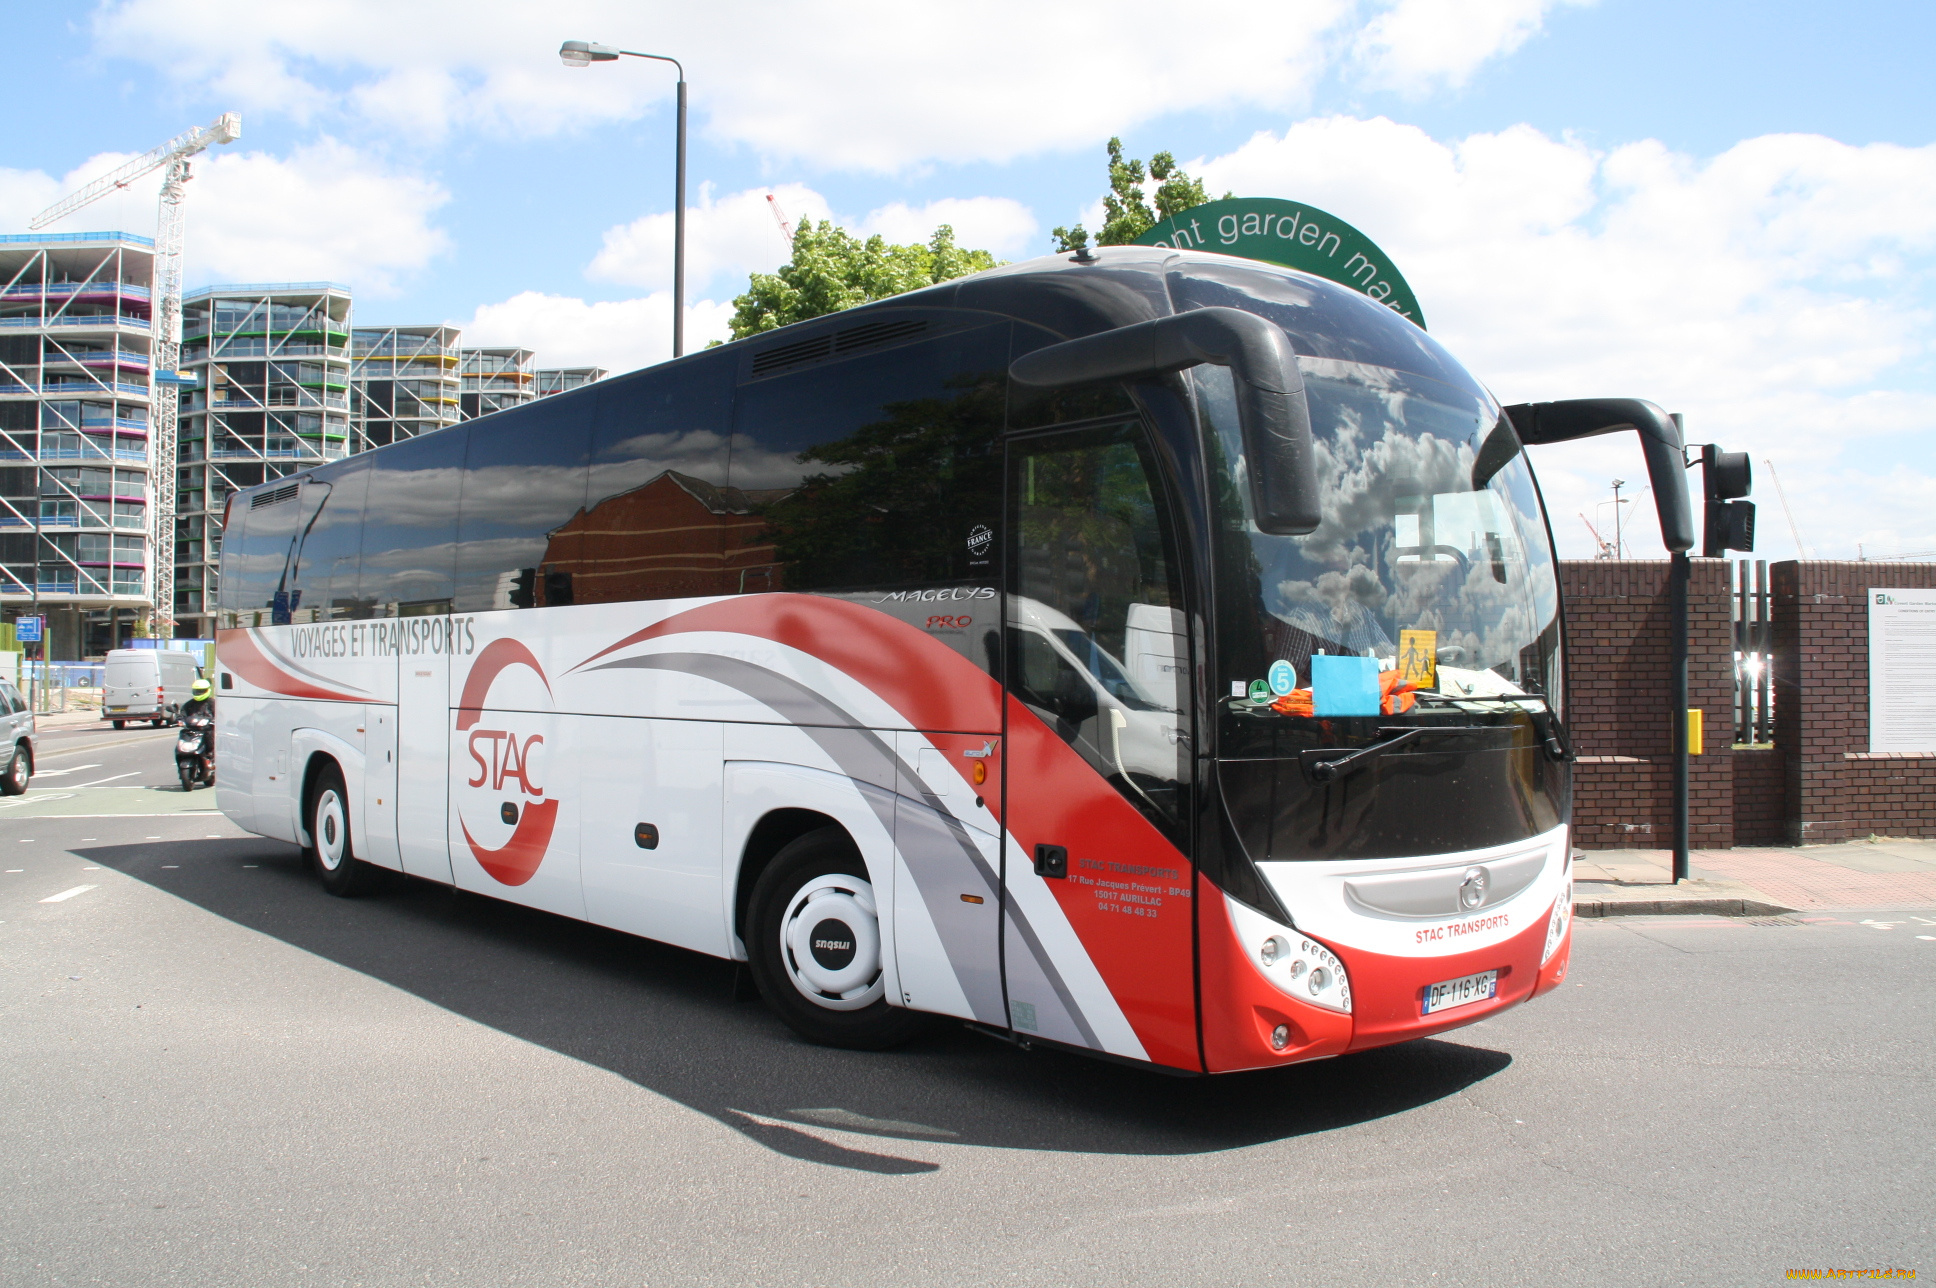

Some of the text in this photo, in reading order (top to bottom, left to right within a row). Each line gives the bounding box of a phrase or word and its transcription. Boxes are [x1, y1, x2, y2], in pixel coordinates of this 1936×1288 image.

[1218, 211, 1341, 257] garden
[1343, 252, 1412, 317] mar
[967, 532, 991, 547] FRANCE
[870, 587, 995, 603] MAGELYS
[926, 615, 972, 628] PRO
[291, 617, 475, 658] VOYAGES ET TRANSPORTS
[1256, 681, 1263, 692] 4
[1276, 672, 1290, 692] 5
[468, 729, 544, 796] STAC
[1079, 858, 1179, 880] STAC TRANSPORTS
[1068, 875, 1077, 883] 17
[1079, 876, 1094, 886] Rue
[1096, 878, 1129, 891] Jacques
[1131, 882, 1162, 895] Prévert
[1168, 887, 1191, 898] BP49
[1094, 890, 1162, 907] 15017 AURILLAC
[1098, 902, 1157, 918] 04 71 48 48 33
[1416, 914, 1509, 943] STAC TRANSPORTS
[1431, 975, 1488, 1007] DF-116-XG
